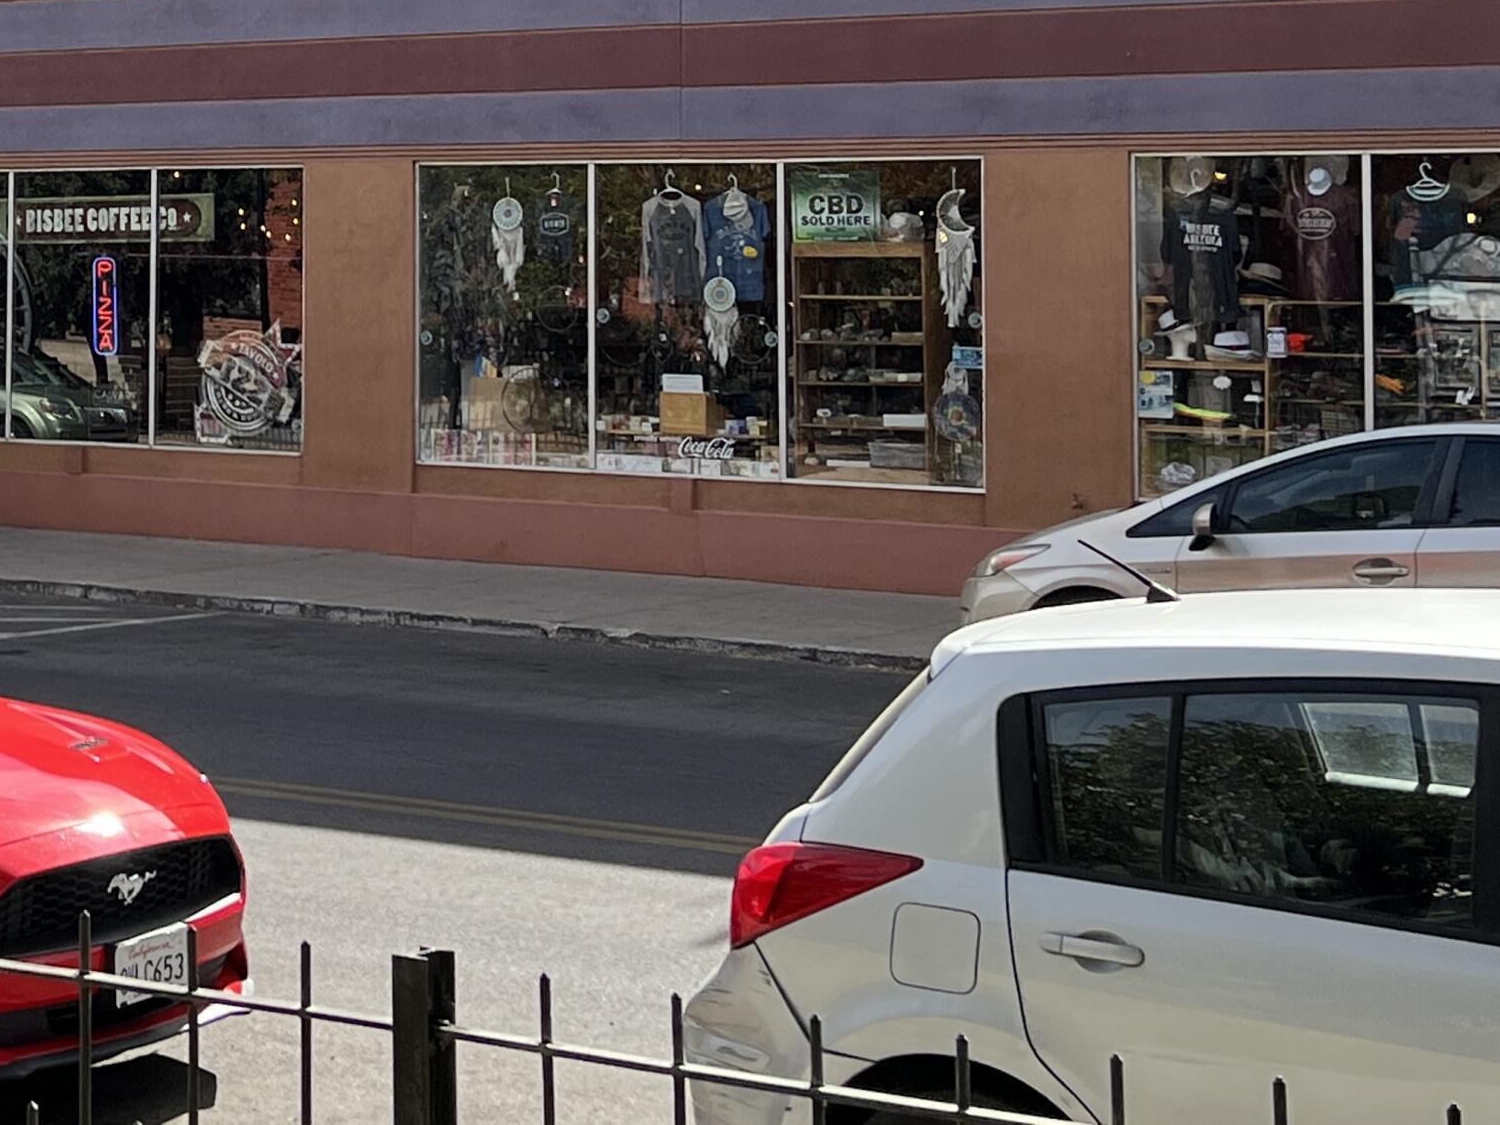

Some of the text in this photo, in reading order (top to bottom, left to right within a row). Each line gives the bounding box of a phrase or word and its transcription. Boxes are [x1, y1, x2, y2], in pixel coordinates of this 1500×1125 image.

[808, 194, 864, 215] CBD
[25, 208, 85, 233] BISBEE
[86, 206, 152, 232] COFFEE
[801, 215, 871, 226] SOLD HERE
[97, 261, 113, 351] PIZZA
[238, 343, 274, 373] TAVOLO
